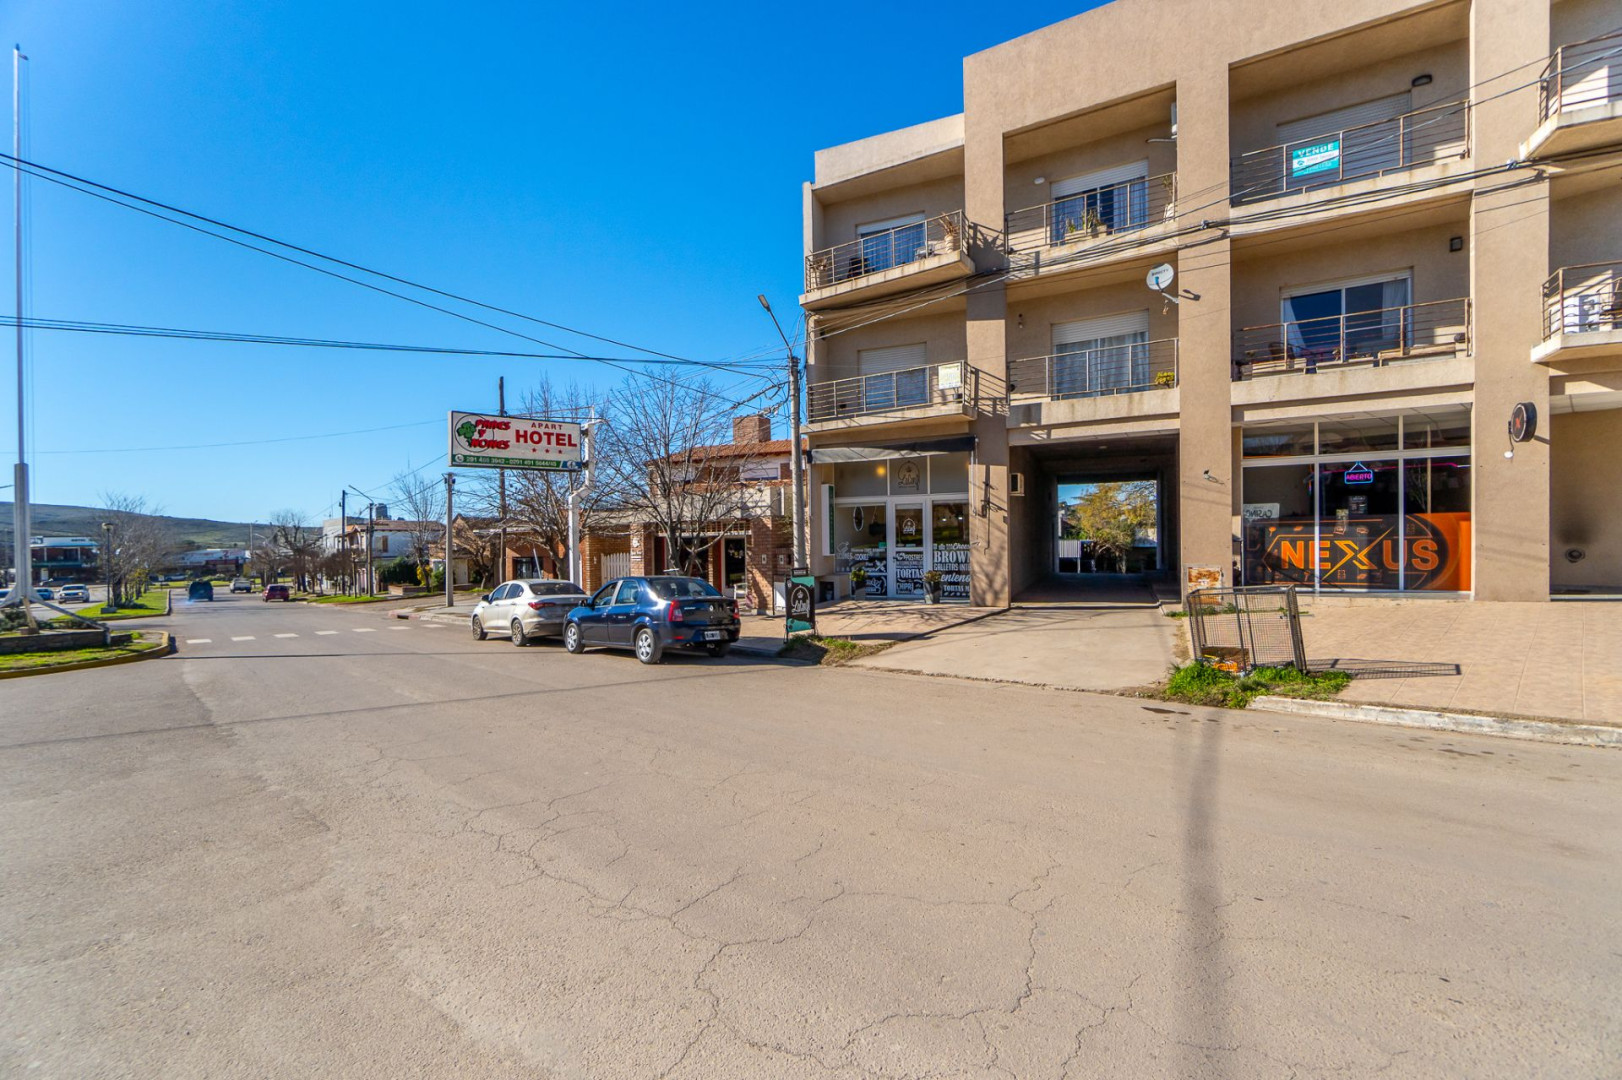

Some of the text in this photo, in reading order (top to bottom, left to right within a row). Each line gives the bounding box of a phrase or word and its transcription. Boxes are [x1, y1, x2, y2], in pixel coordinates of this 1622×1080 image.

[1298, 142, 1335, 158] VENDE
[530, 421, 563, 431] APART
[470, 438, 511, 450] NONES
[514, 429, 578, 448] HOTEL
[1346, 473, 1373, 481] ABIERTO
[1281, 531, 1440, 577] NEXUS
[897, 568, 924, 579] TORTAS
